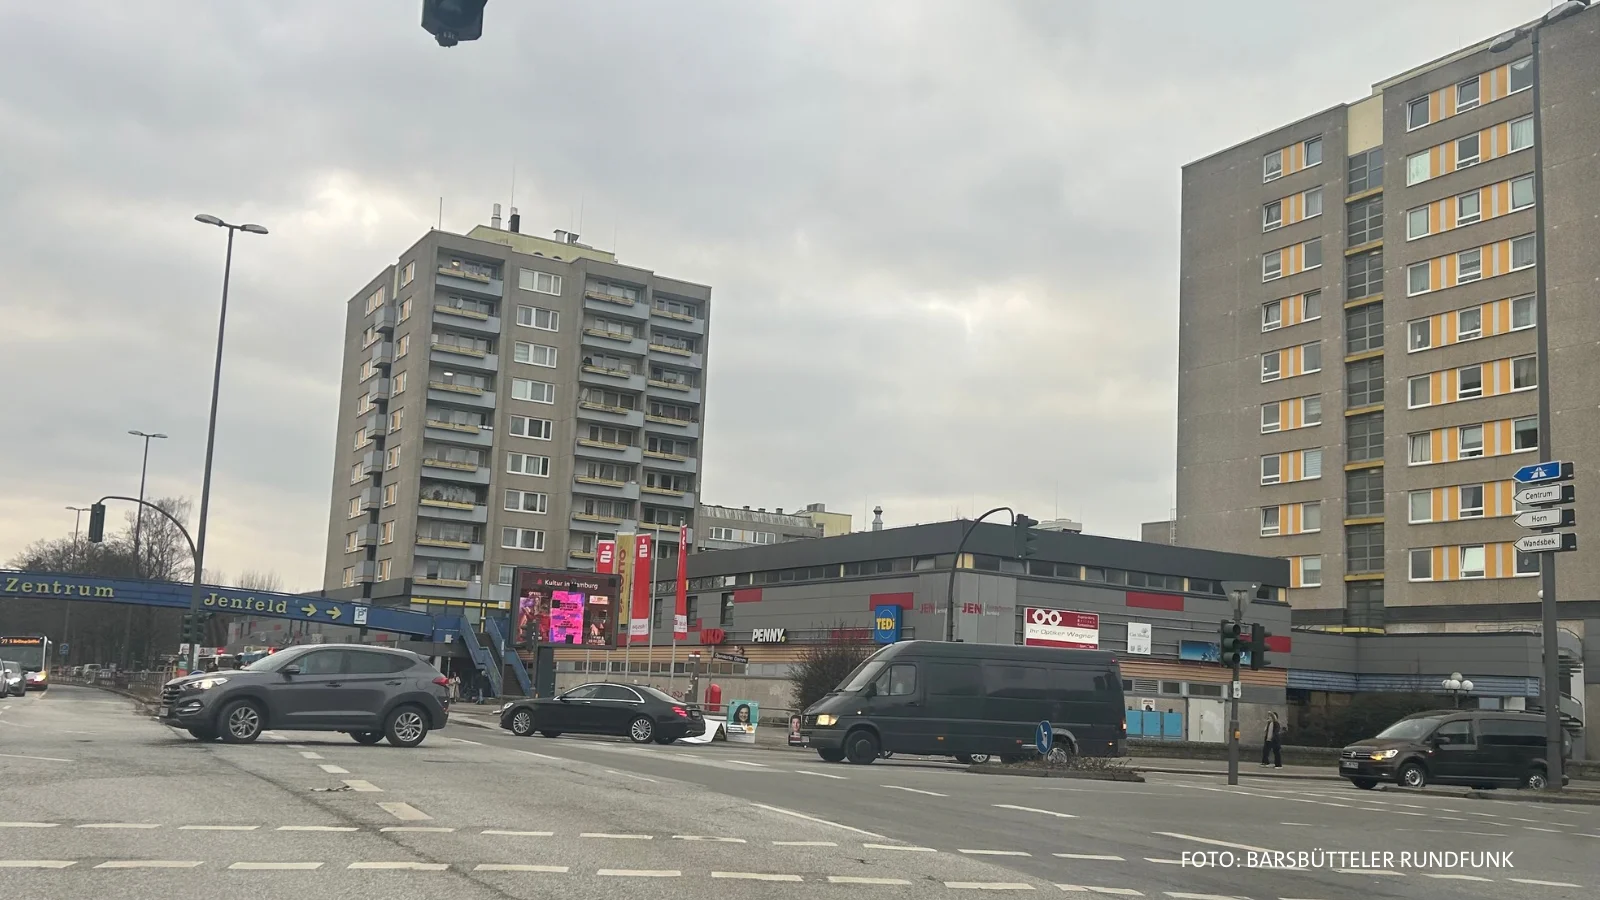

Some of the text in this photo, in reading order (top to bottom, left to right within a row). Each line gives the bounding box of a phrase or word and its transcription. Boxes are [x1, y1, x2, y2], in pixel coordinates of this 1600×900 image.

[1525, 490, 1552, 500] Centrum
[1531, 515, 1547, 523] Horn
[1523, 537, 1555, 547] Wandsbek
[544, 579, 563, 587] Kultur
[5, 577, 287, 614] Zentrum Jenfeld
[919, 603, 935, 614] JEN
[962, 602, 982, 614] JEN
[876, 617, 895, 631] TEDi
[700, 628, 725, 645] NKD
[1040, 629, 1065, 637] Optiker
[1066, 631, 1095, 640] Wagner
